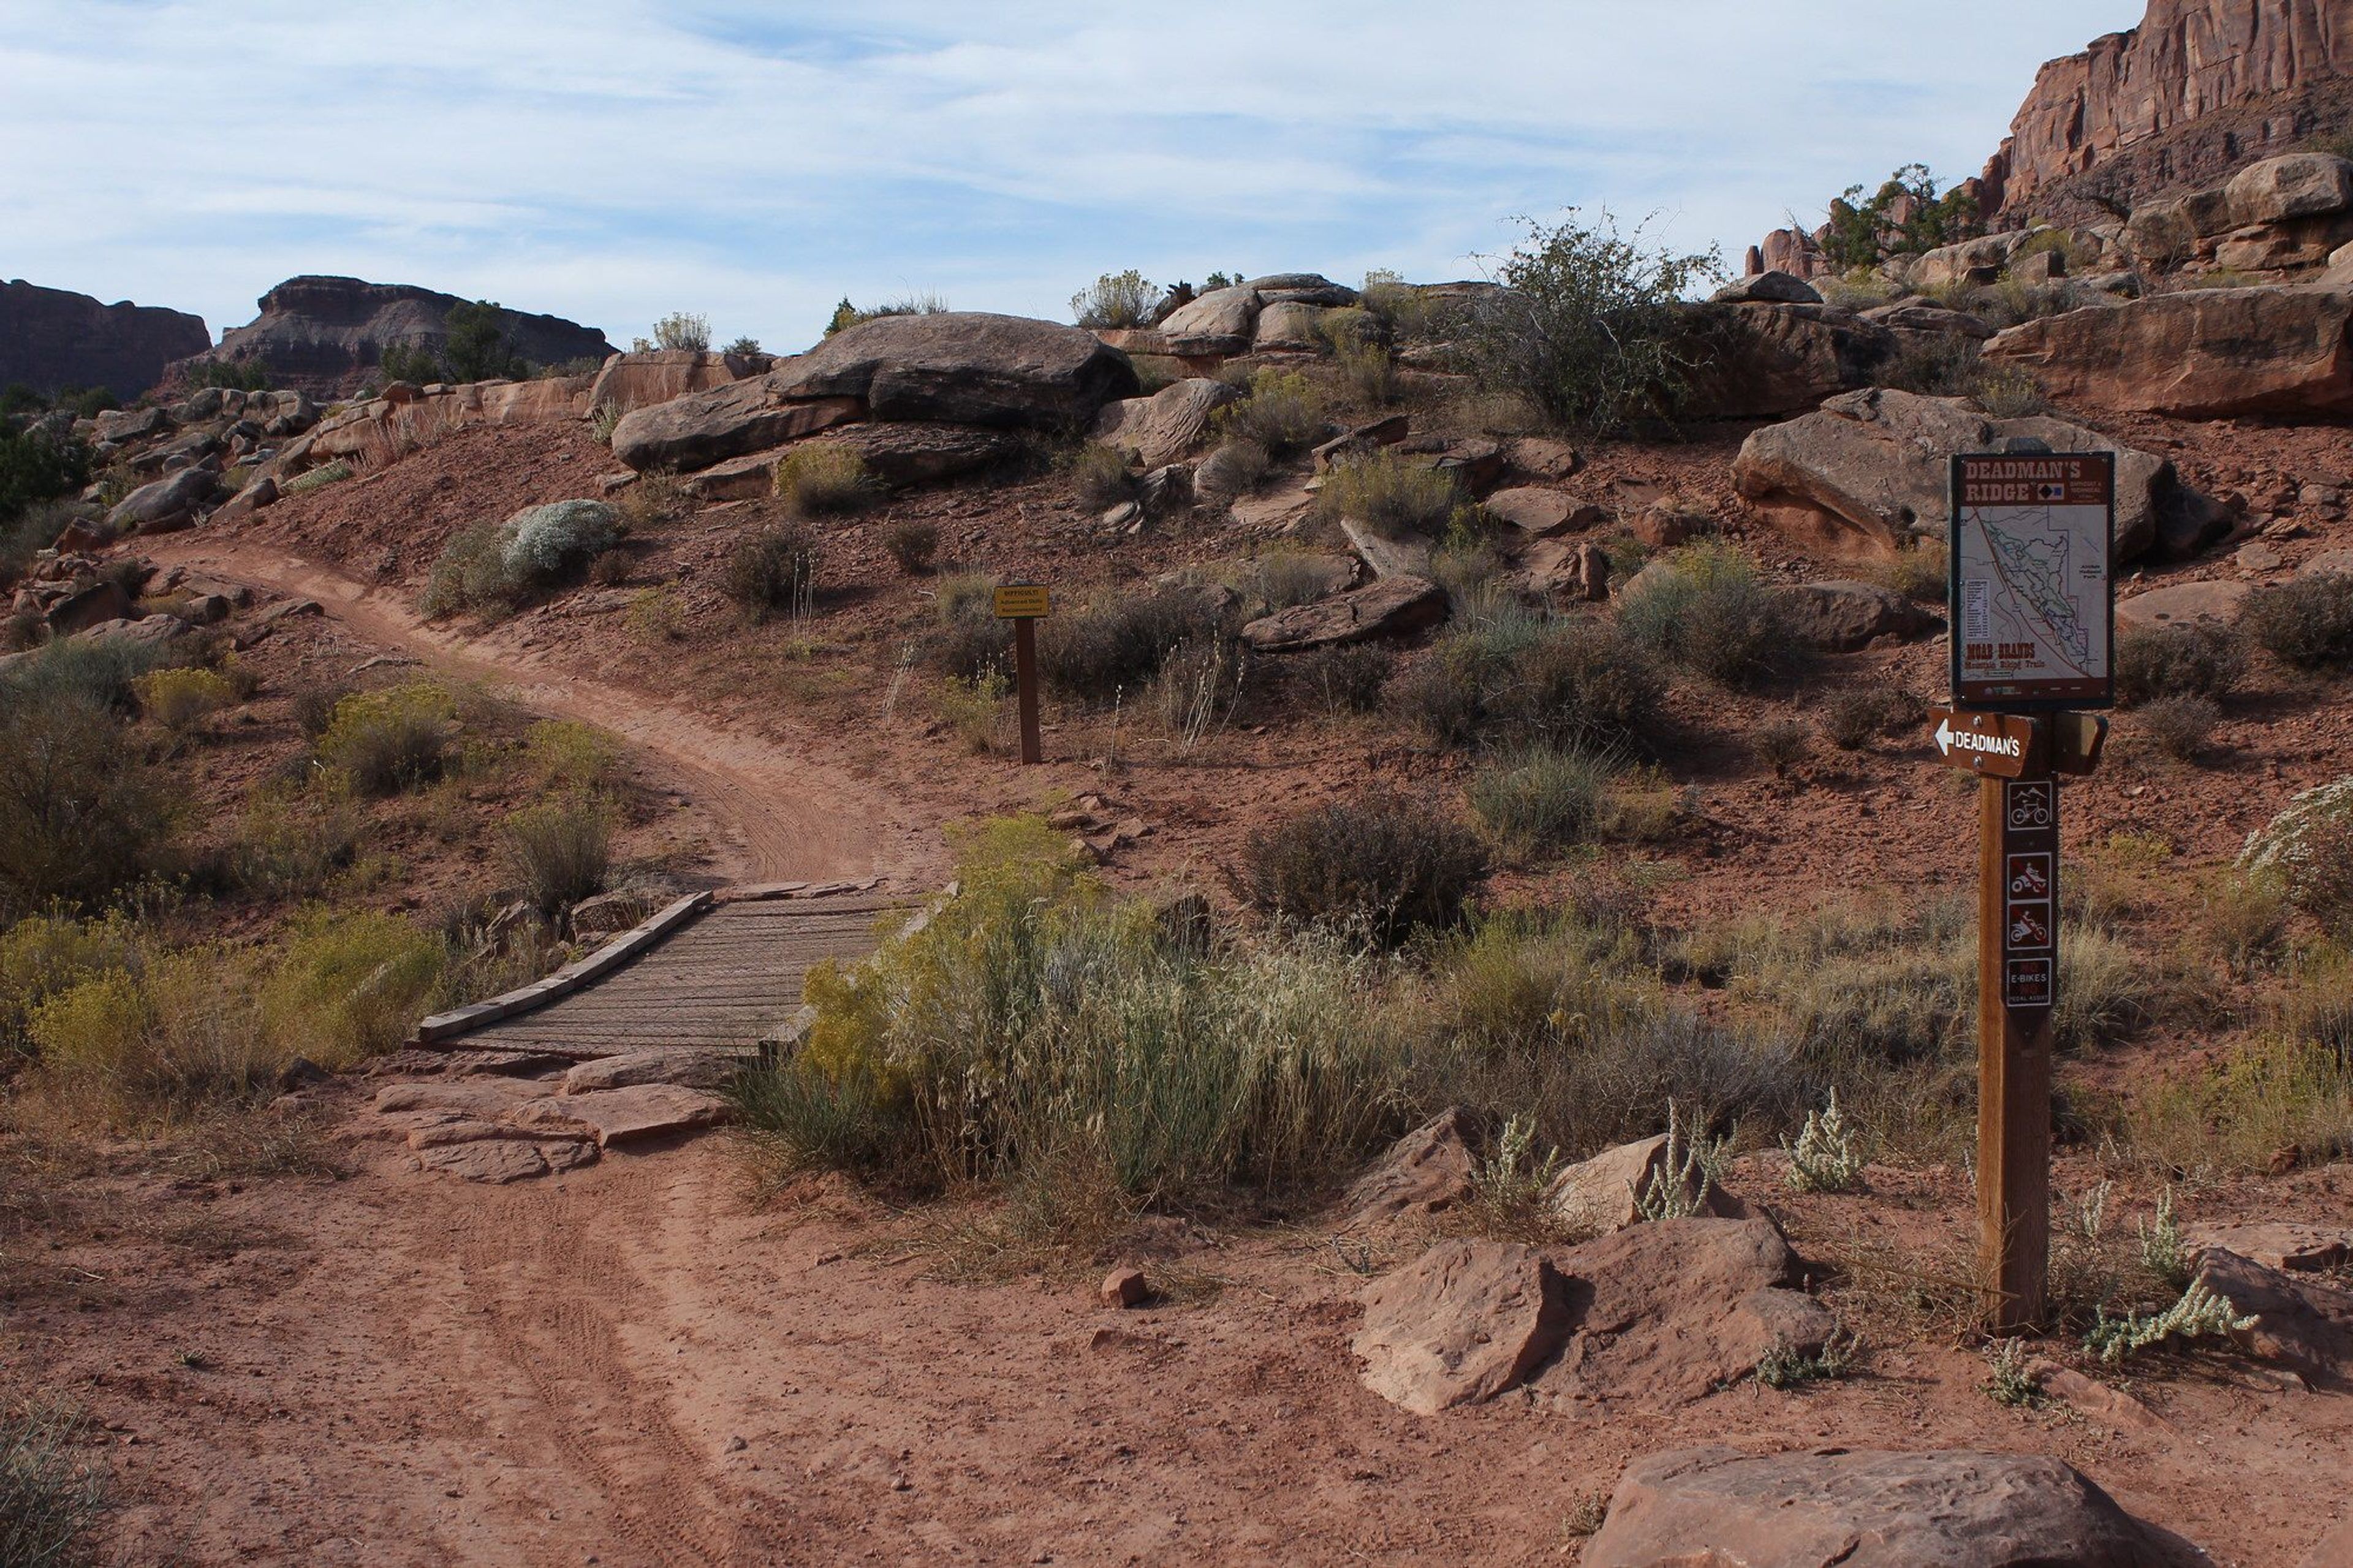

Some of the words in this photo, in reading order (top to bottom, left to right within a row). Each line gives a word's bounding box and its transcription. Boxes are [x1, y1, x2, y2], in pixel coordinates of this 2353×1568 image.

[1965, 461, 2081, 479] DEADMAN'S
[1965, 483, 2029, 501] RIDGE
[1966, 643, 1993, 660] MOAB
[1998, 643, 2035, 659] BRANDS
[1955, 731, 2020, 757] DEADMAN'S
[2011, 974, 2047, 983] E-BIKES
